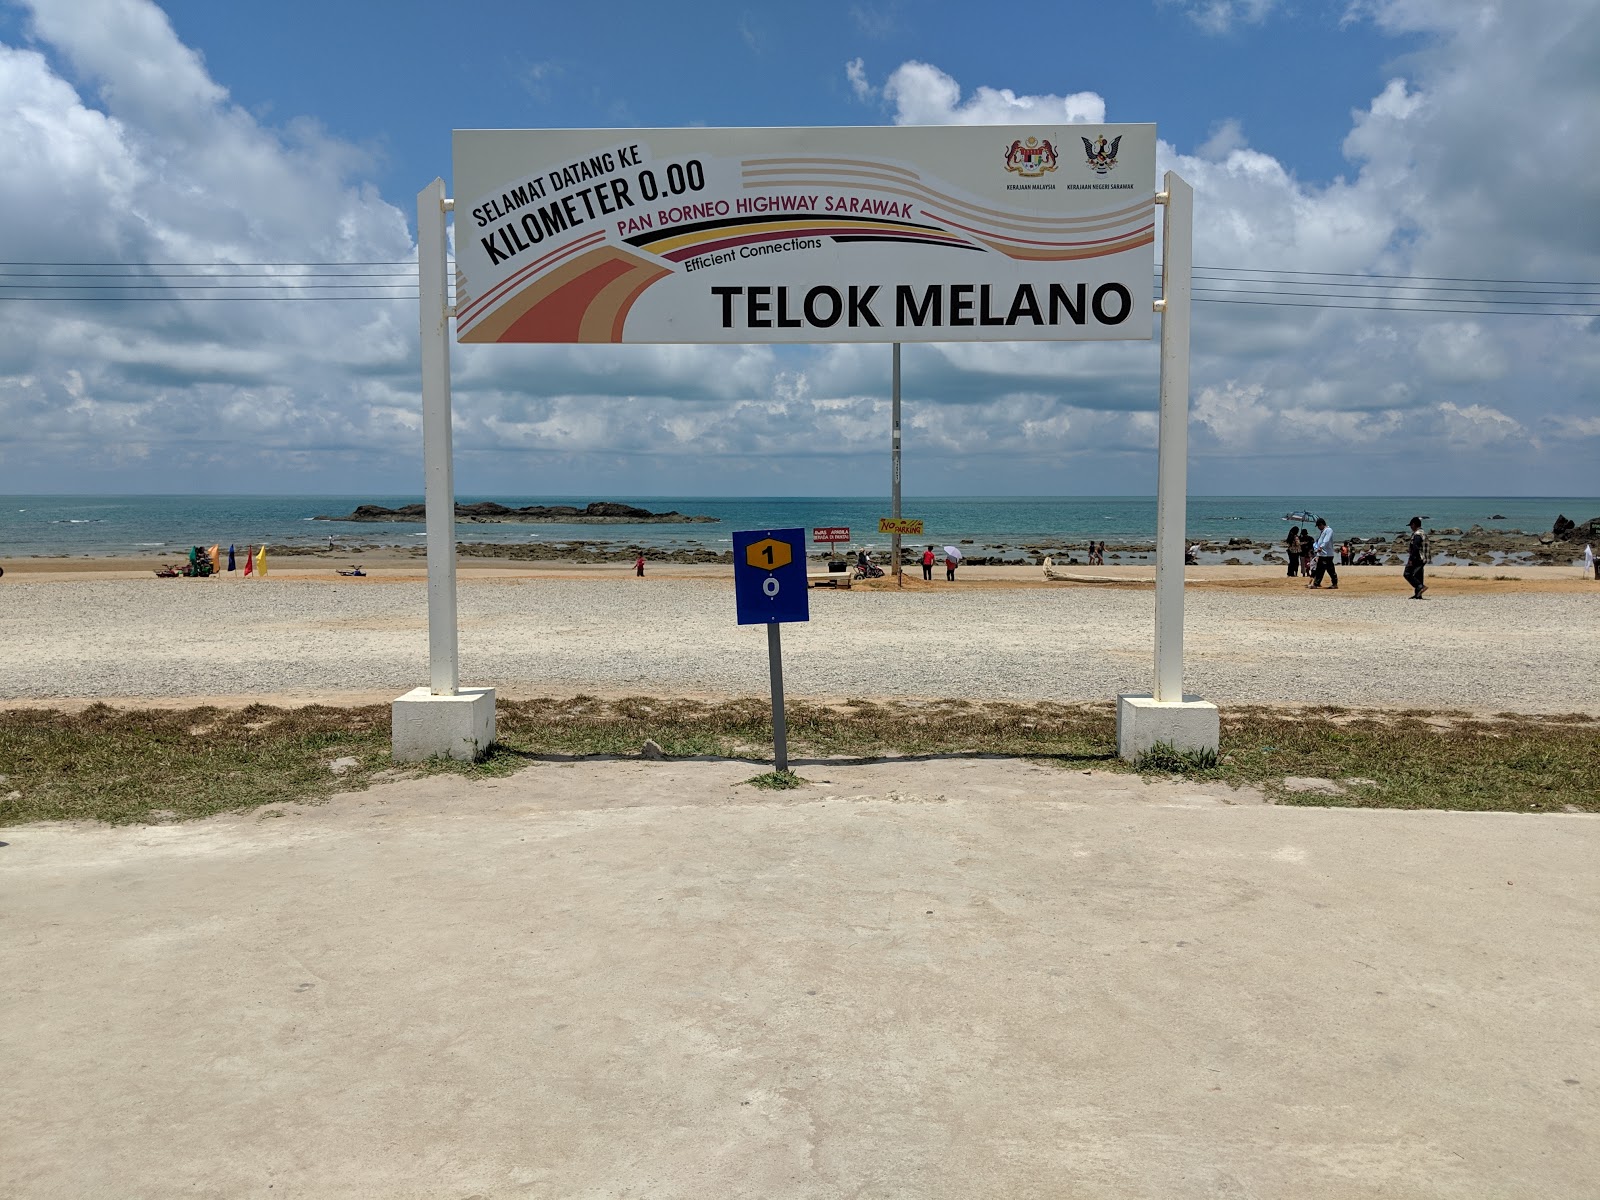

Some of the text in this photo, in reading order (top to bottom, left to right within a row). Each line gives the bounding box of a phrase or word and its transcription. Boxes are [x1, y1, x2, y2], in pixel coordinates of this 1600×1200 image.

[472, 144, 643, 228] SELAMAT DATANG KE
[480, 159, 706, 266] KILOMETER 0.00
[616, 195, 914, 237] PAN BORNEO HIGHWAY SARAWAK
[684, 237, 823, 273] Efficient Connections
[711, 282, 1134, 328] TELOK MELANO
[881, 522, 895, 531] NO
[762, 546, 774, 564] 1
[763, 578, 780, 597] 0
